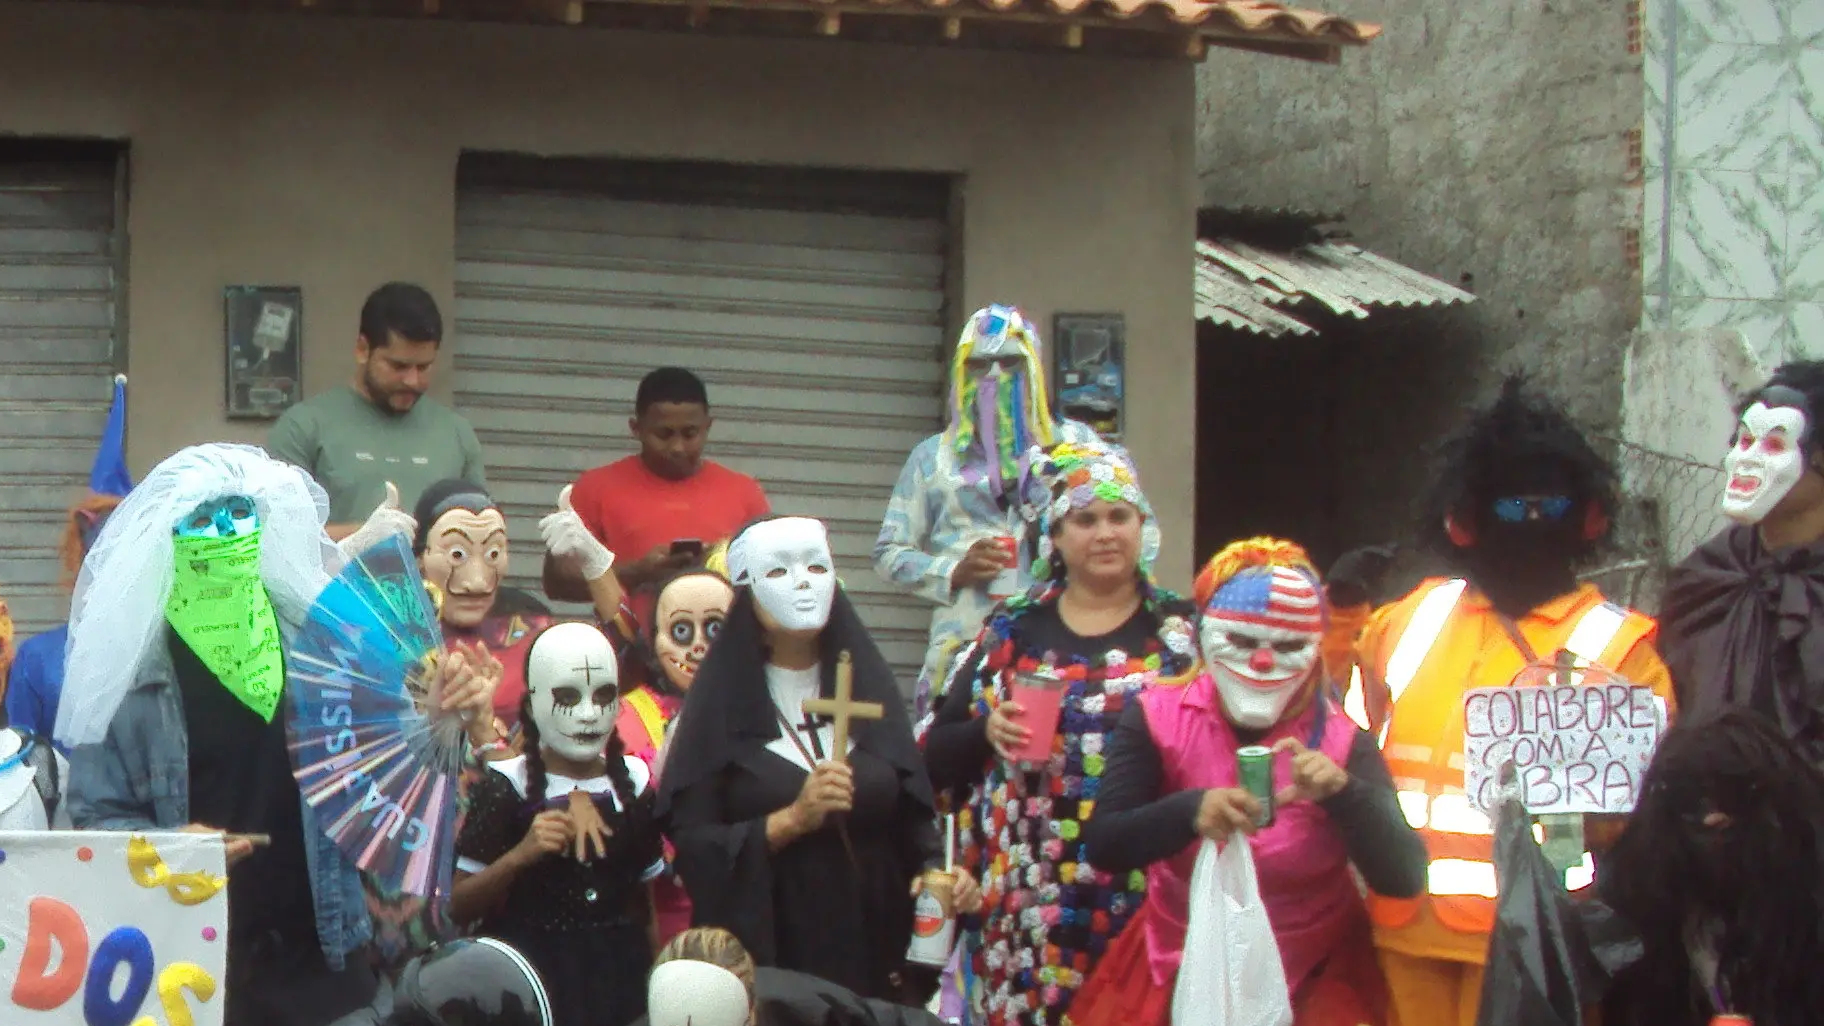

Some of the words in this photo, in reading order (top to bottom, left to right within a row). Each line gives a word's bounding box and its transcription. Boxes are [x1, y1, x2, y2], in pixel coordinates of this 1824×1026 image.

[1464, 685, 1654, 738] COLABORE
[1482, 733, 1565, 768] COM
[1580, 732, 1612, 761] A
[1477, 760, 1634, 811] CBRA
